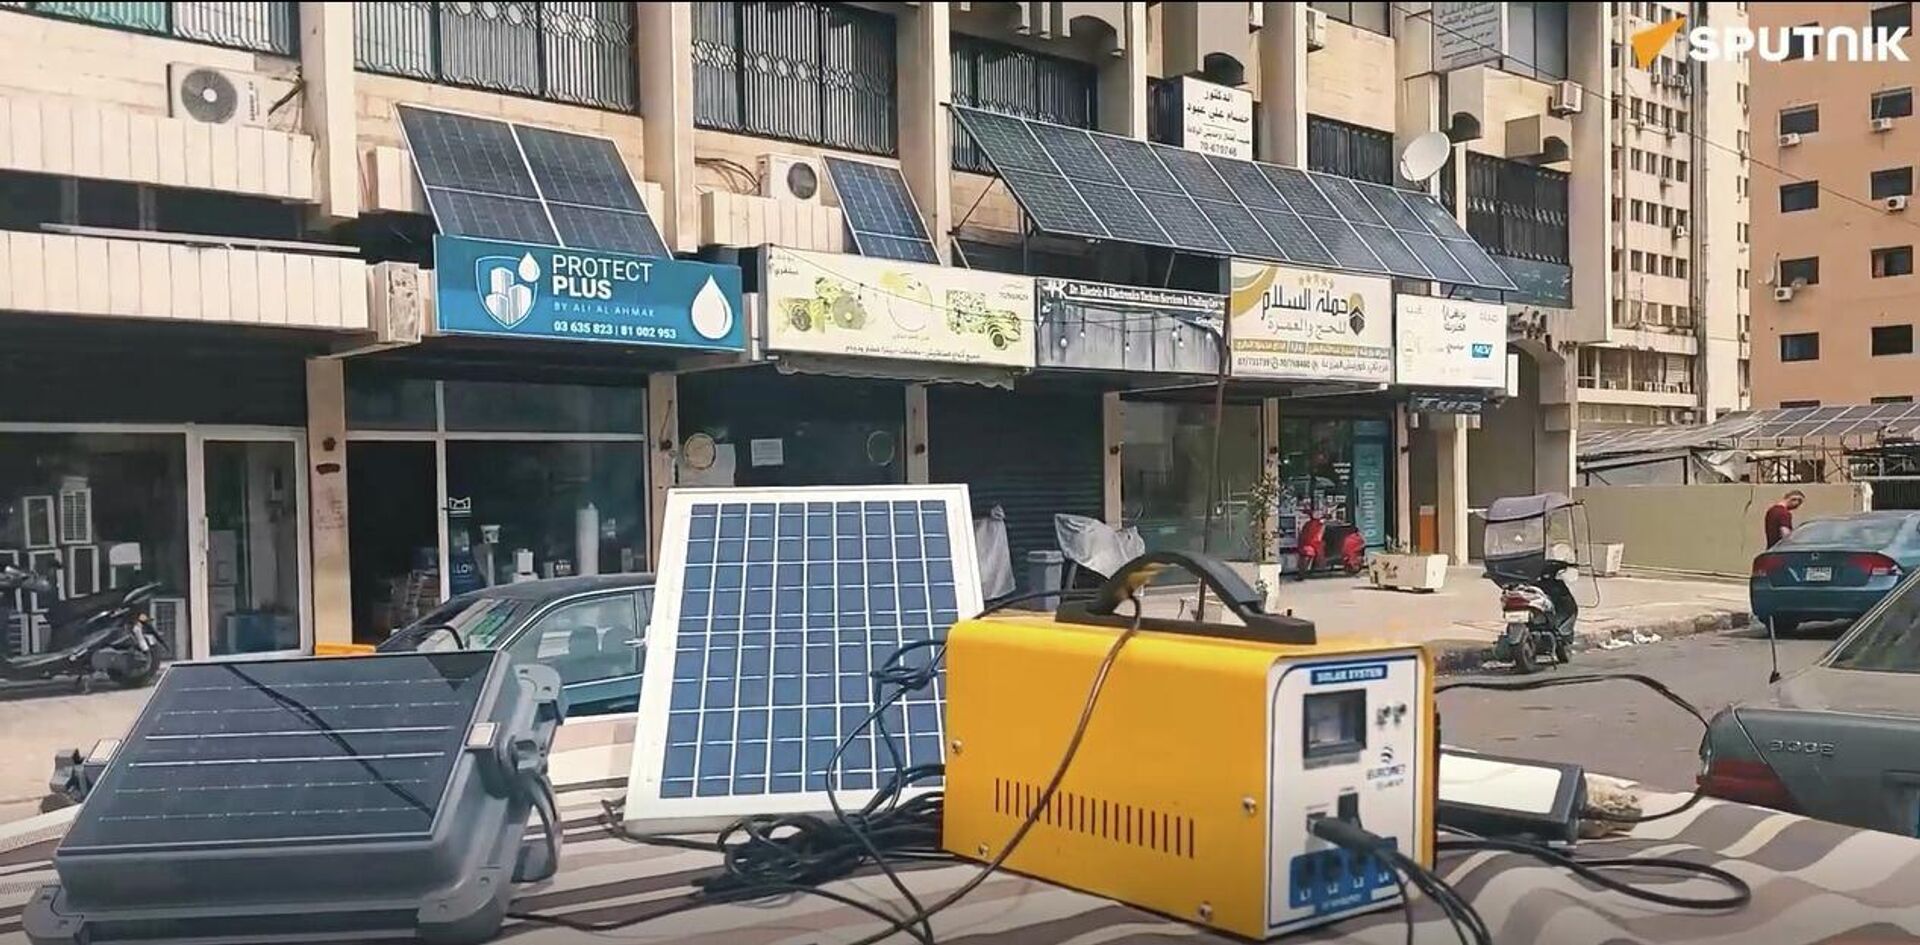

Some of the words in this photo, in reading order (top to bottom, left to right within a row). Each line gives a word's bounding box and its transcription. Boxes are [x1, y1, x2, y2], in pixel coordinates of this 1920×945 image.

[552, 254, 653, 283] PROTECT
[552, 275, 612, 300] PLUS
[554, 302, 567, 312] BY
[573, 303, 591, 313] ALI
[597, 305, 609, 315] AL
[1260, 284, 1311, 321] السلام
[1315, 289, 1349, 316] حملة
[553, 321, 568, 332] 03
[570, 322, 591, 334] 635
[592, 323, 613, 335] 823
[621, 326, 633, 336] 81
[636, 326, 656, 338] 002
[657, 328, 677, 339] 953
[1267, 317, 1314, 338] والعمرة
[1315, 320, 1347, 340] للحج
[1317, 671, 1347, 683] SOLAR
[1349, 667, 1384, 680] SYSTEM
